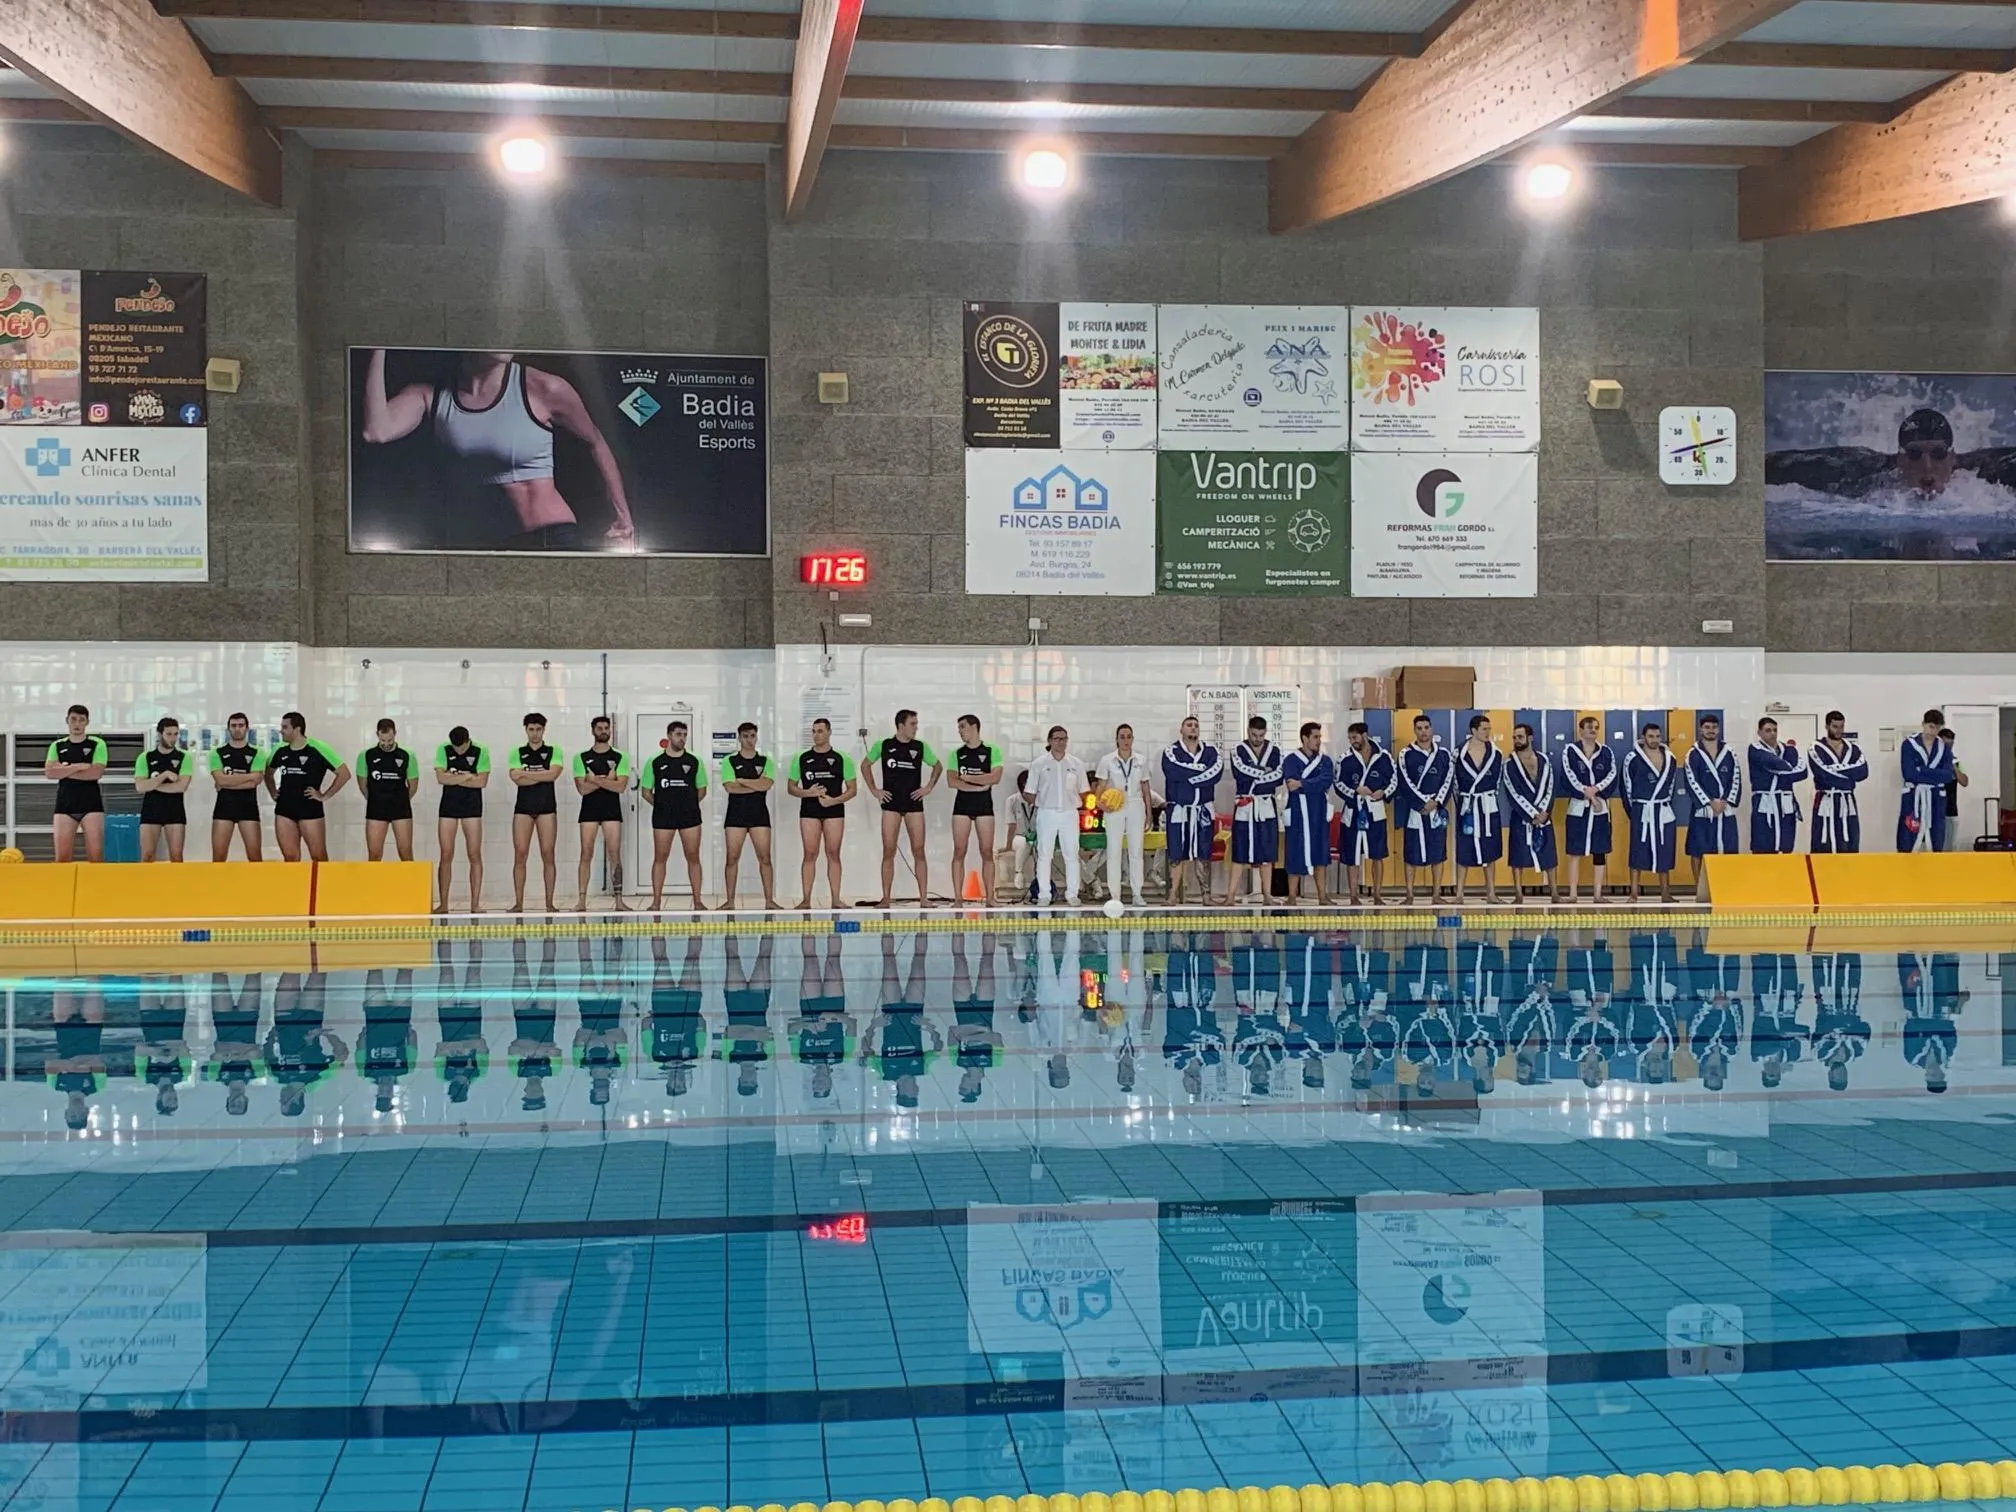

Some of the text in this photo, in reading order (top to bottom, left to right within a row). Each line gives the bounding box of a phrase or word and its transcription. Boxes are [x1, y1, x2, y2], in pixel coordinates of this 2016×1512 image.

[1068, 321, 1148, 332] DE FRUTA MADRE
[88, 334, 134, 342] MEXICANO
[980, 322, 1002, 350] ESTANCO
[1003, 322, 1017, 333] DE
[1016, 328, 1029, 341] LA
[1024, 340, 1040, 379] GLORIETA
[1070, 339, 1146, 350] MONTSE & LIDIA
[1266, 344, 1327, 356] ANA
[1457, 345, 1527, 361] Carnisseria
[667, 373, 755, 385] Ajuntament de
[1460, 364, 1525, 386] ROSI
[683, 393, 755, 416] Badia
[699, 419, 755, 430] del Vallès
[699, 434, 756, 451] Esports
[81, 448, 140, 462] ANFER
[133, 465, 176, 477] Dental
[1190, 452, 1317, 500] Vantrip
[76, 491, 149, 506] sonrisas
[153, 495, 202, 506] sanas
[57, 516, 71, 528] de
[91, 517, 119, 528] años
[132, 518, 144, 528] tu
[148, 516, 172, 528] lado
[1000, 514, 1122, 529] FINCAS BADIA
[1216, 515, 1261, 523] LLOGUER
[1182, 526, 1261, 536] CAMPERITZACIÓ
[1387, 524, 1432, 532] REFORMAS
[1457, 524, 1487, 532] GORDO
[1207, 540, 1261, 550] MECÀNICA
[1177, 572, 1237, 580] www.vantrip.es
[1310, 579, 1341, 587] camper
[1253, 691, 1292, 699] VISITANTE
